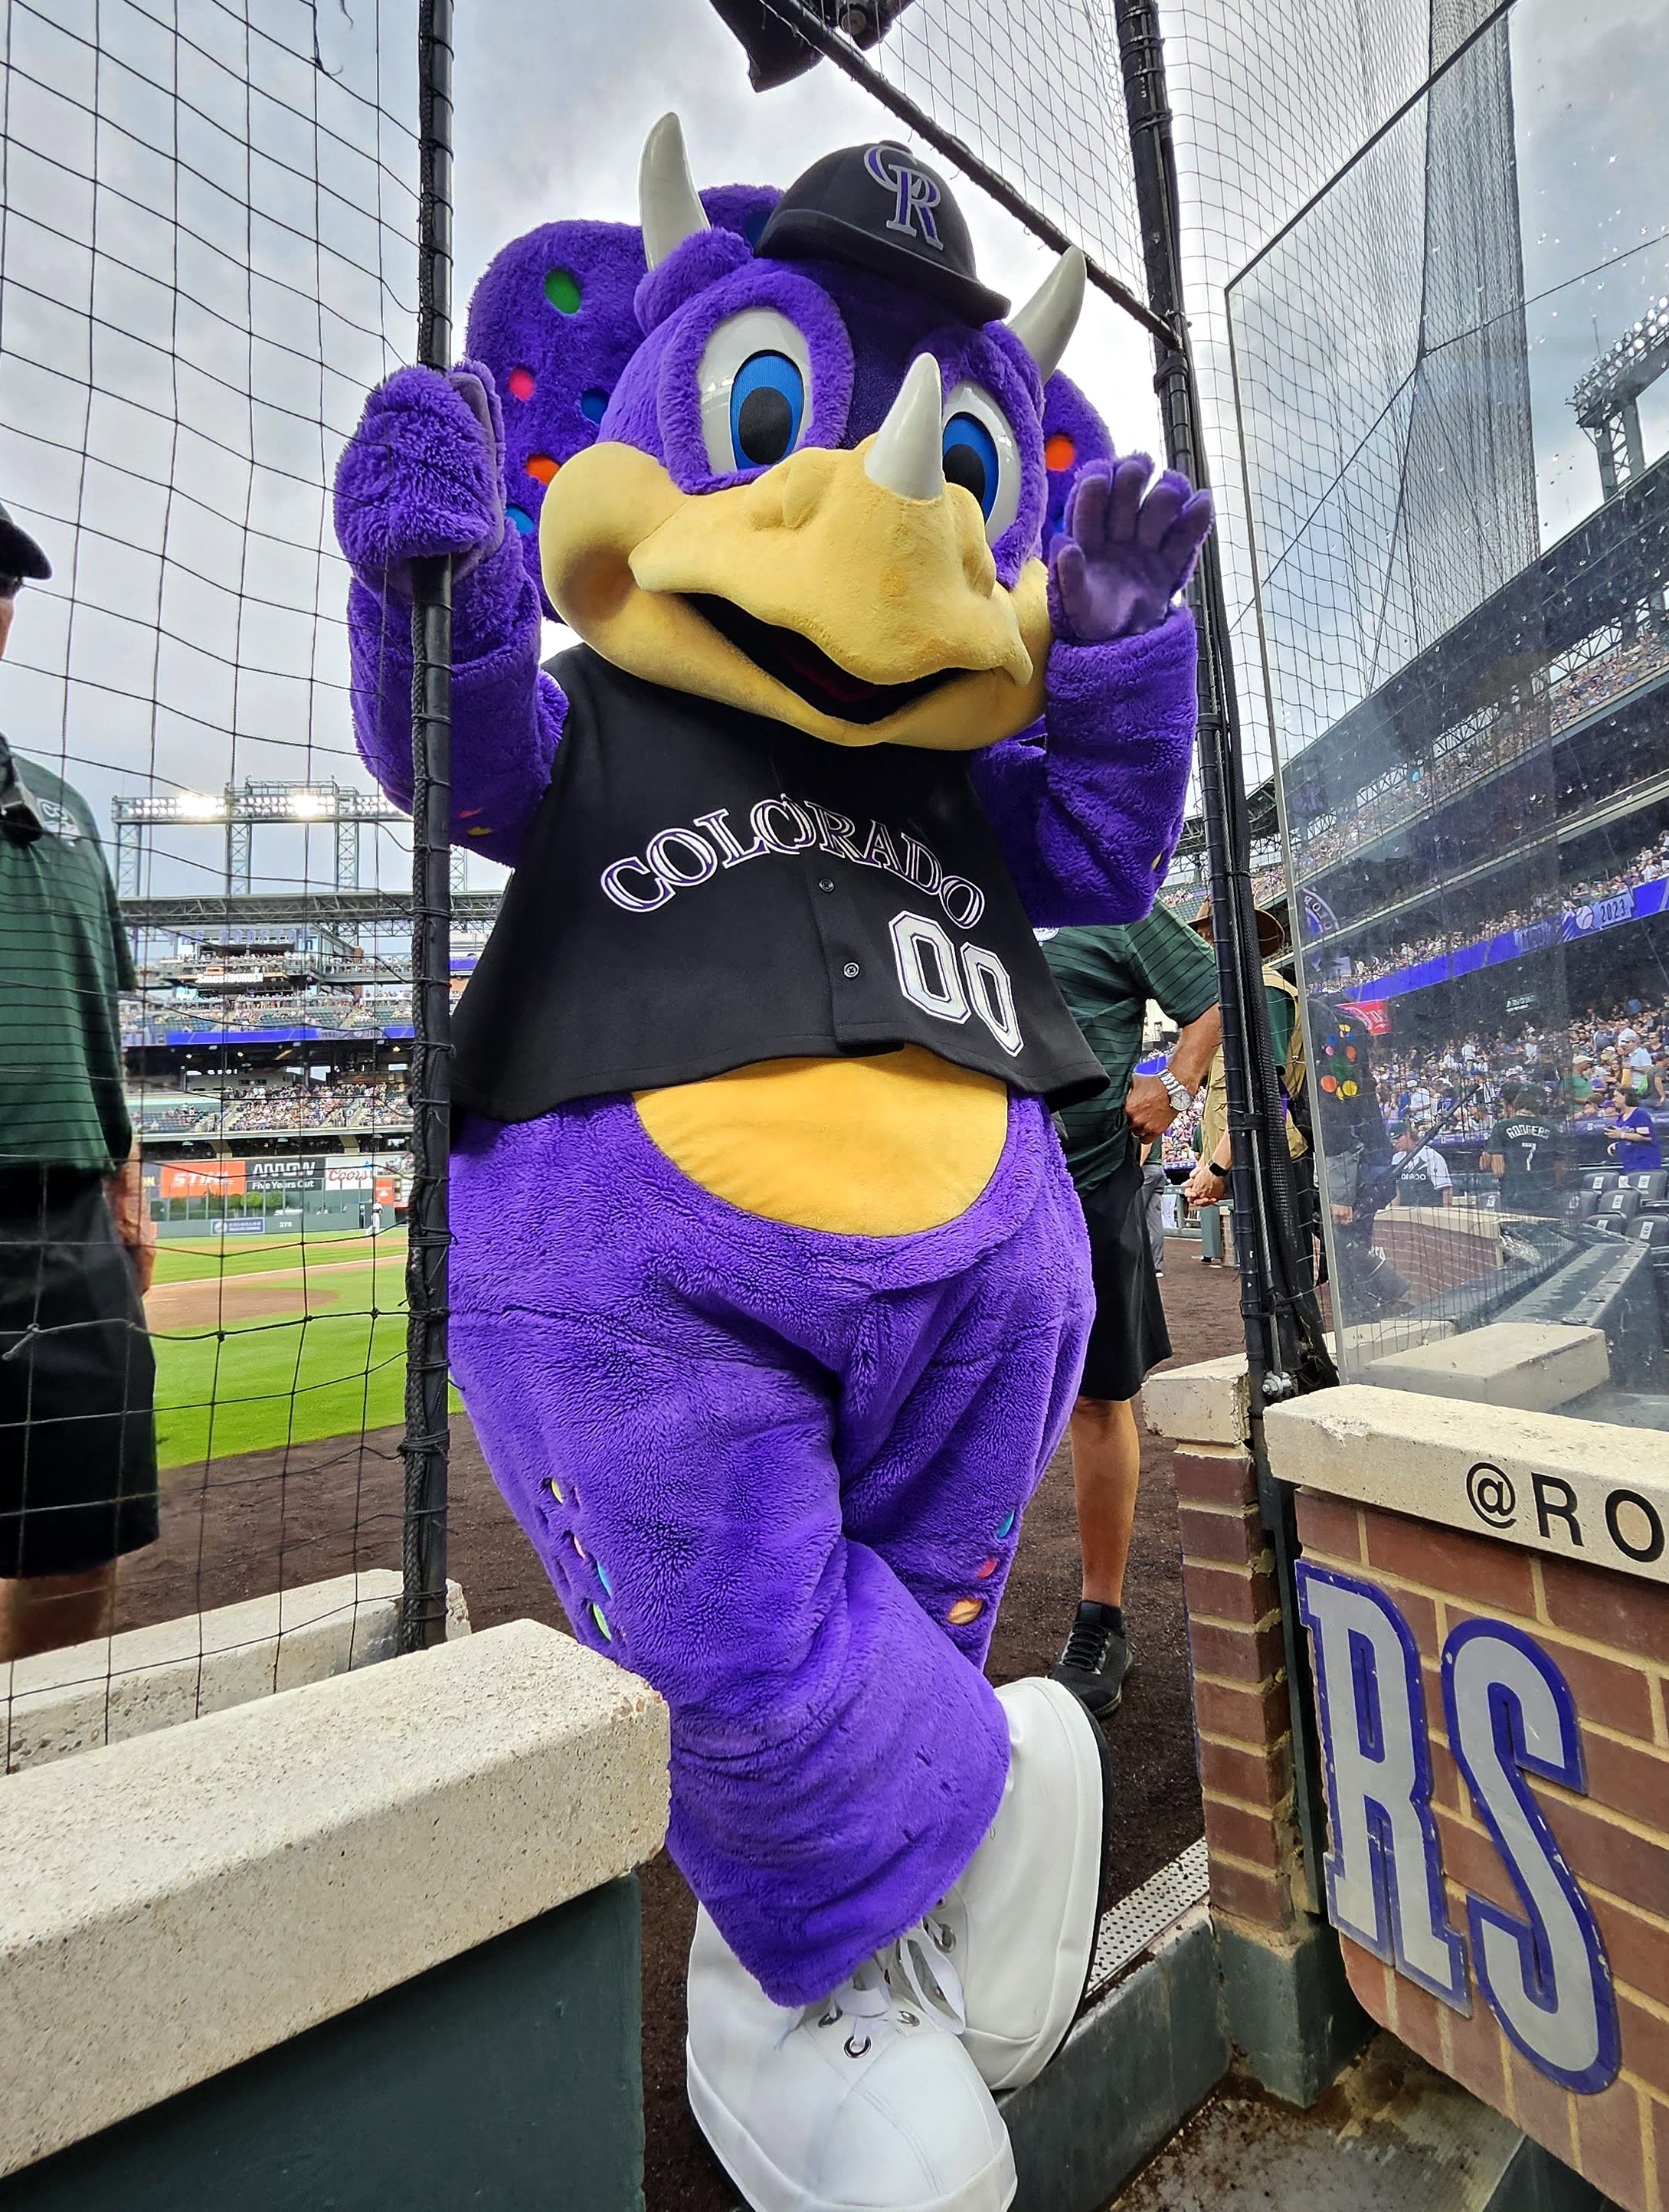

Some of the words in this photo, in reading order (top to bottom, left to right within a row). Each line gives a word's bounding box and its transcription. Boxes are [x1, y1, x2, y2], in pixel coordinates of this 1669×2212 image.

[600, 794, 985, 929] COLORADO
[1599, 898, 1626, 923] 2023
[888, 910, 1024, 1058] 00
[252, 1161, 316, 1177] ARROW
[1521, 1142, 1536, 1172] 7
[252, 1181, 271, 1189] Five
[271, 1181, 296, 1189] Years
[297, 1180, 315, 1189] Out
[328, 1169, 369, 1181] Coors
[1294, 1559, 1623, 2096] RS
